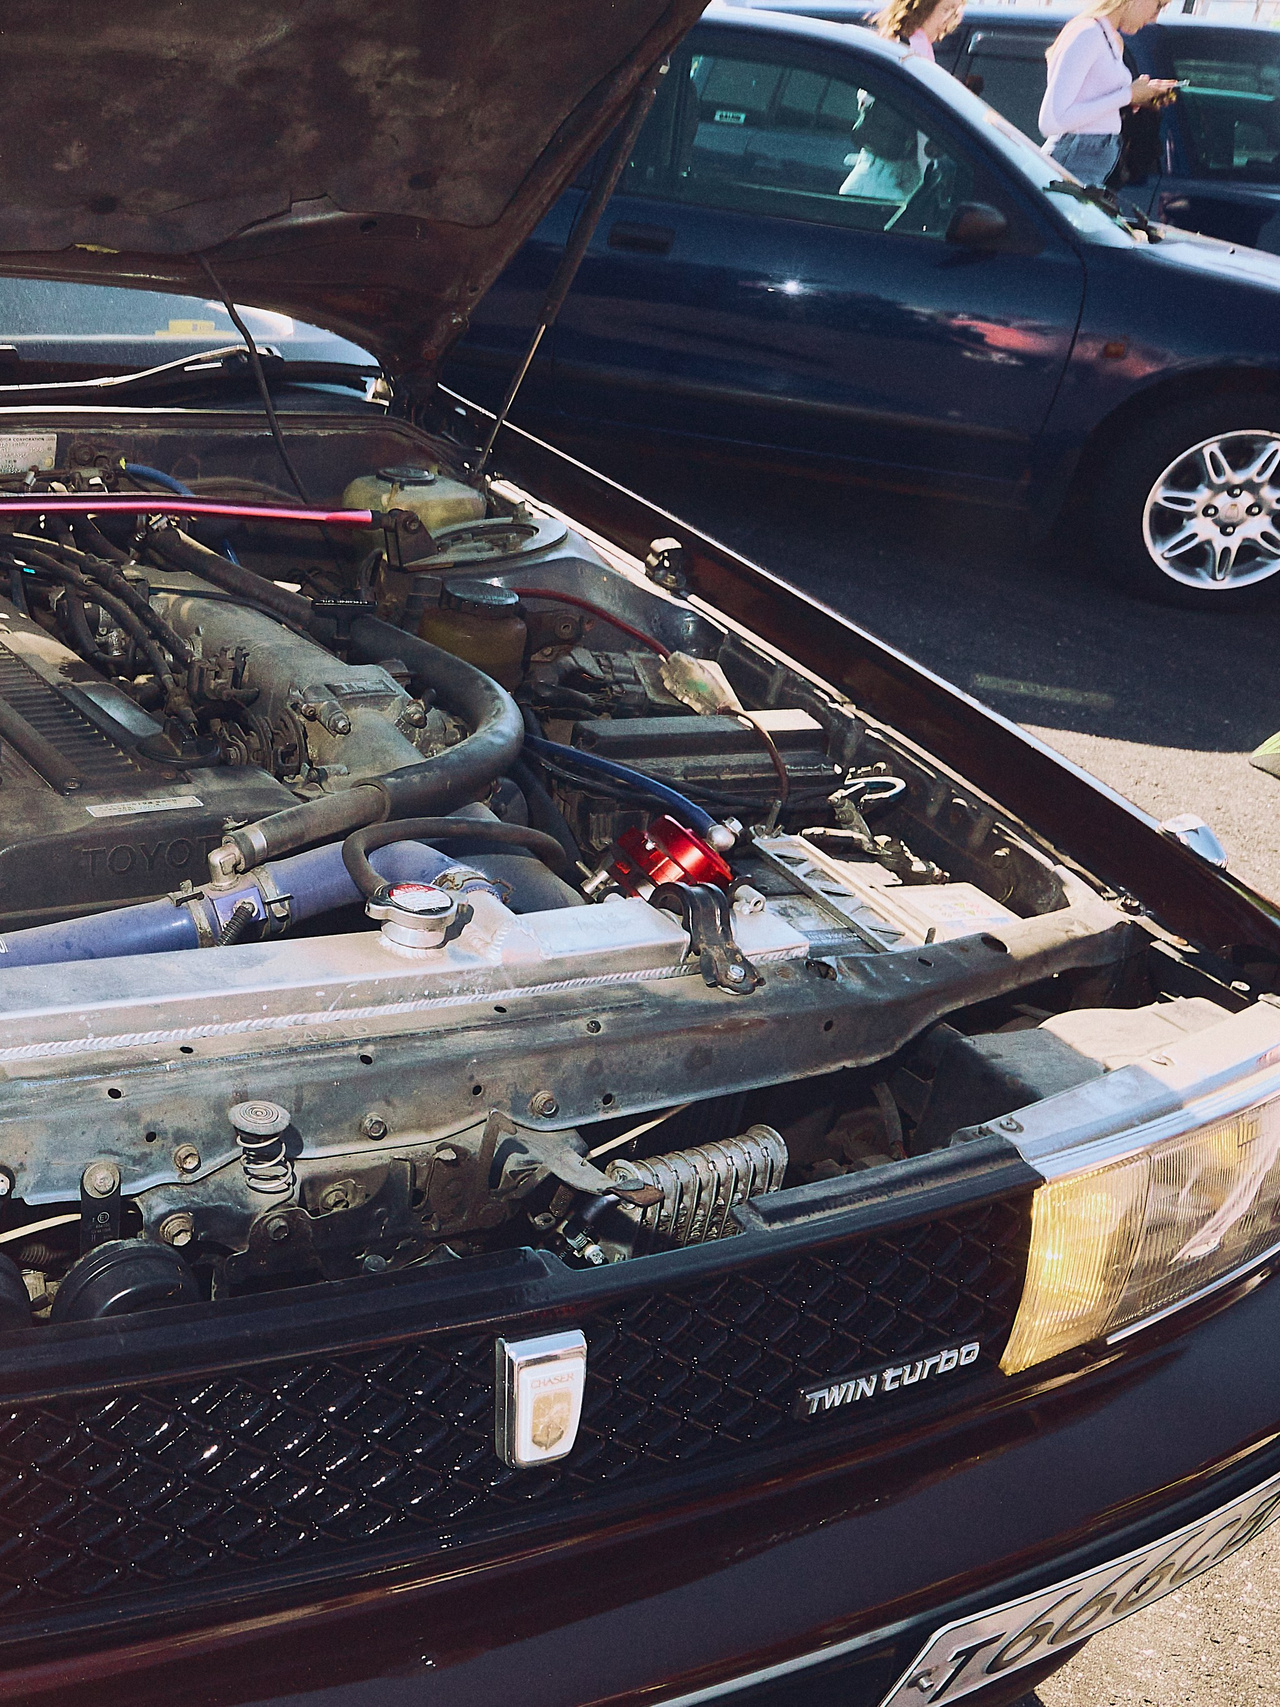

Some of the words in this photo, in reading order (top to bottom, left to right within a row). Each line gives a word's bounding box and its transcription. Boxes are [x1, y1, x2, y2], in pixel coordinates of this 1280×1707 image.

[81, 834, 220, 876] TOYOT
[530, 1372, 574, 1389] CHASER
[806, 1374, 878, 1415] TWIN
[882, 1341, 981, 1392] turbo
